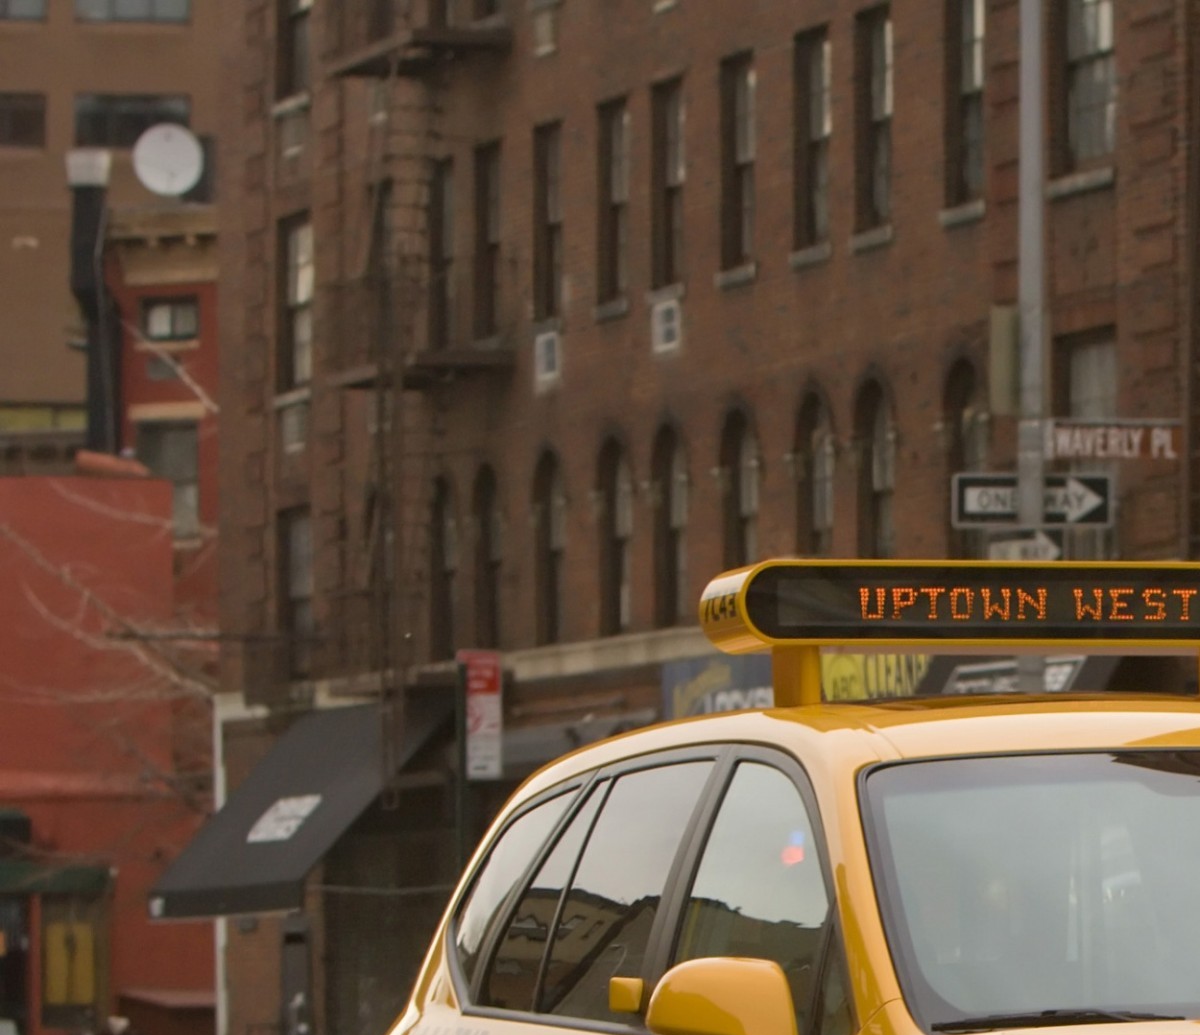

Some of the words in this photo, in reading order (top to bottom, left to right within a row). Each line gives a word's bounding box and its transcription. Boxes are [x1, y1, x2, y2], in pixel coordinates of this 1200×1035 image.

[1055, 427, 1143, 458] WAVERLY
[1151, 427, 1178, 459] PL
[859, 588, 1048, 620] UPTOWN
[1073, 588, 1197, 620] WEST
